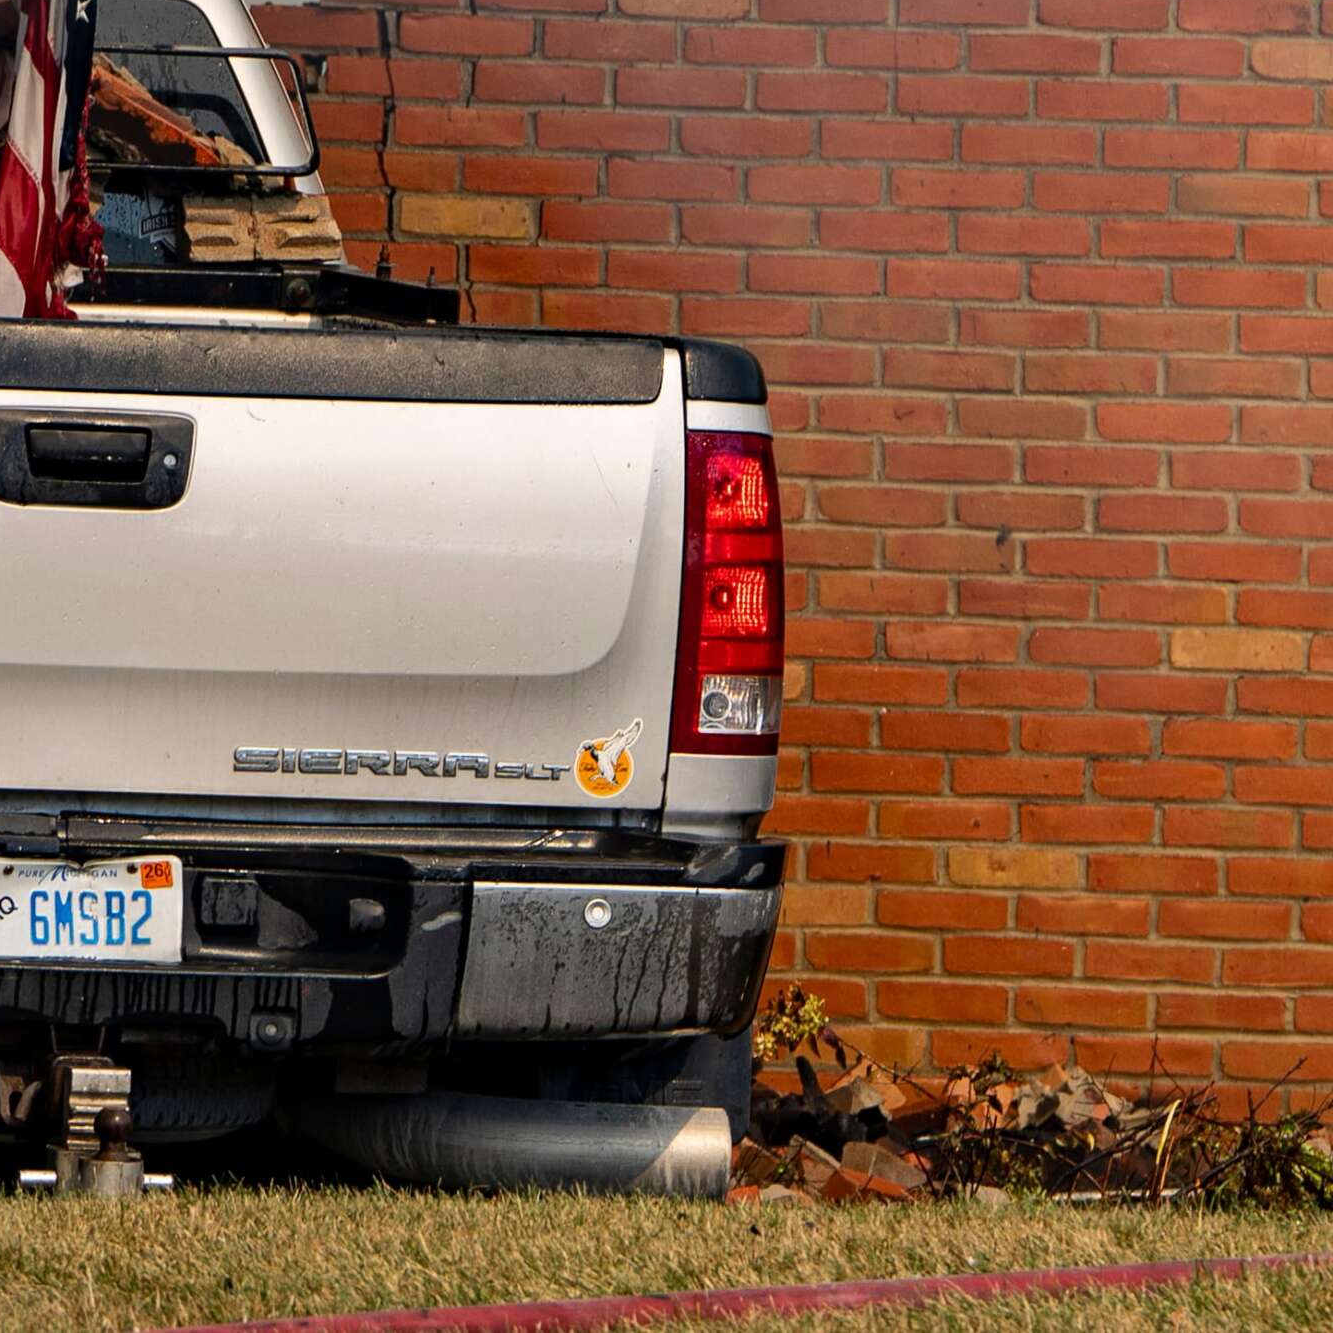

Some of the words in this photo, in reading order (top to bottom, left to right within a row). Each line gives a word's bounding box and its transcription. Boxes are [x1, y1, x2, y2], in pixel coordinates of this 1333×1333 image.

[142, 216, 169, 233] IRISH
[232, 745, 490, 779] SIERRA
[493, 761, 571, 781] SLT
[18, 869, 45, 879] PURE
[39, 864, 119, 885] MGAN
[143, 863, 165, 879] 26
[29, 889, 153, 946] 6MSB2
